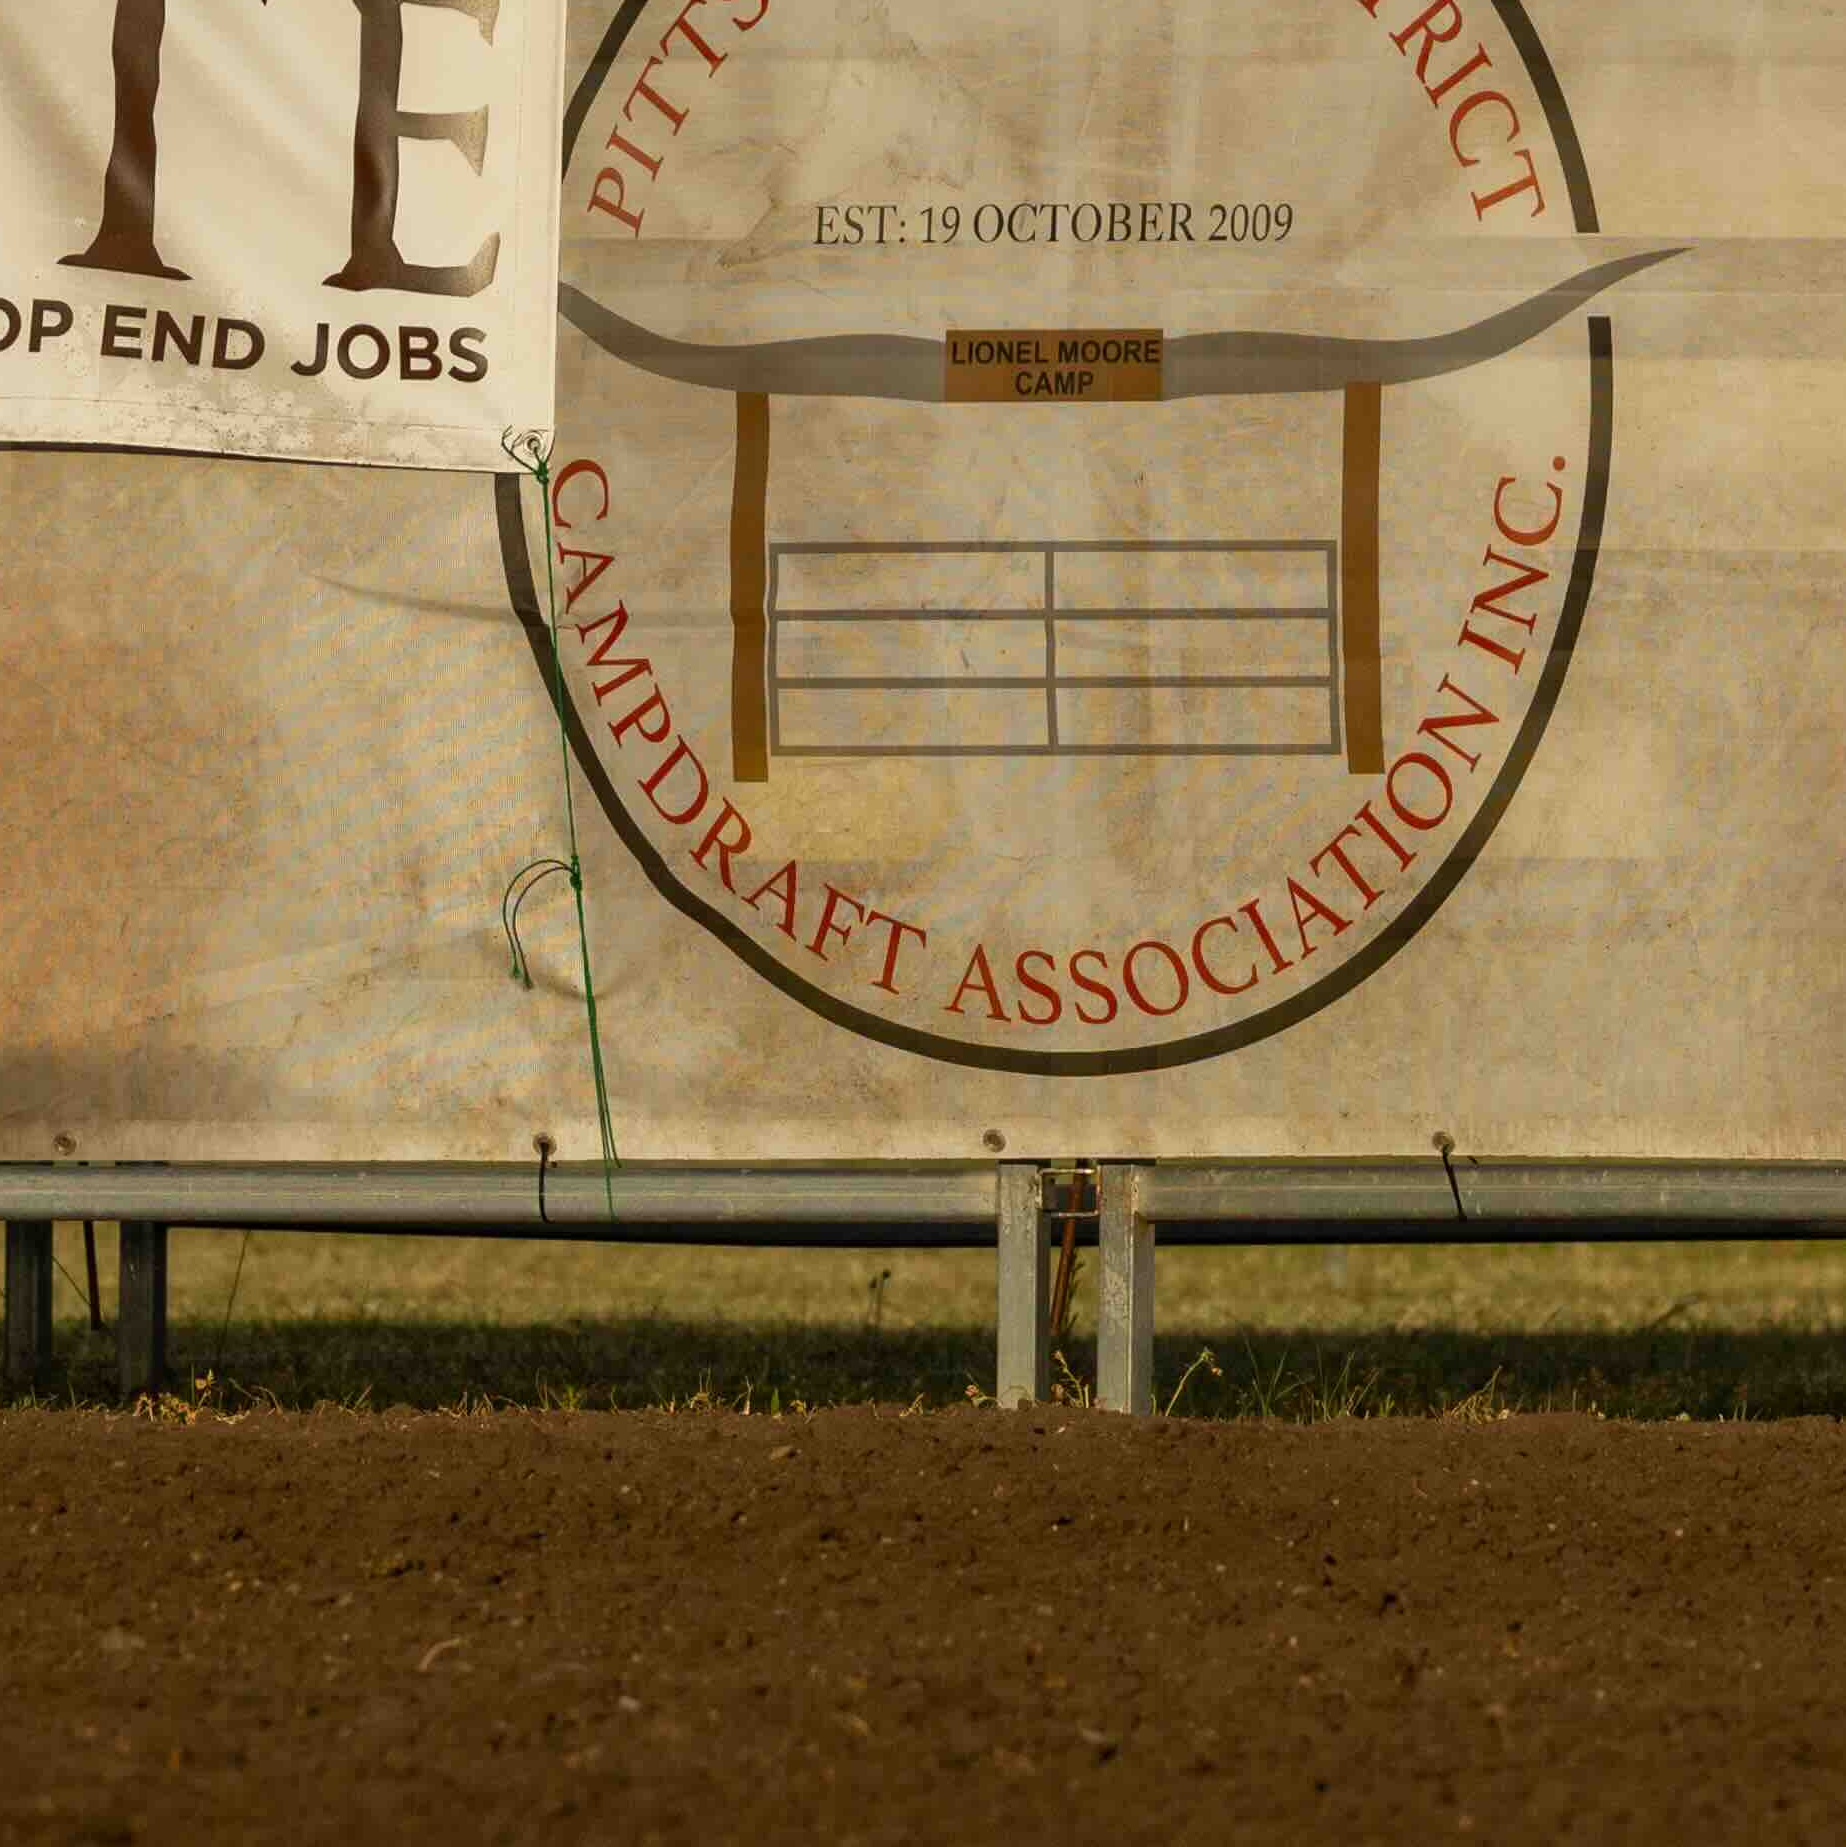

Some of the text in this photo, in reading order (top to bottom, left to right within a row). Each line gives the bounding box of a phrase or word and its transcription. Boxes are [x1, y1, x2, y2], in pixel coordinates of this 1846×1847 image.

[814, 202, 1295, 246] EST: 19 OCTOBER 2009
[98, 305, 265, 370] END
[289, 321, 489, 382] JOBS
[950, 339, 1161, 365] LIONEL MOORE
[1014, 370, 1094, 397] CAMP
[551, 453, 1566, 1023] CAMPDRAFT ASSOCIATION INC.
